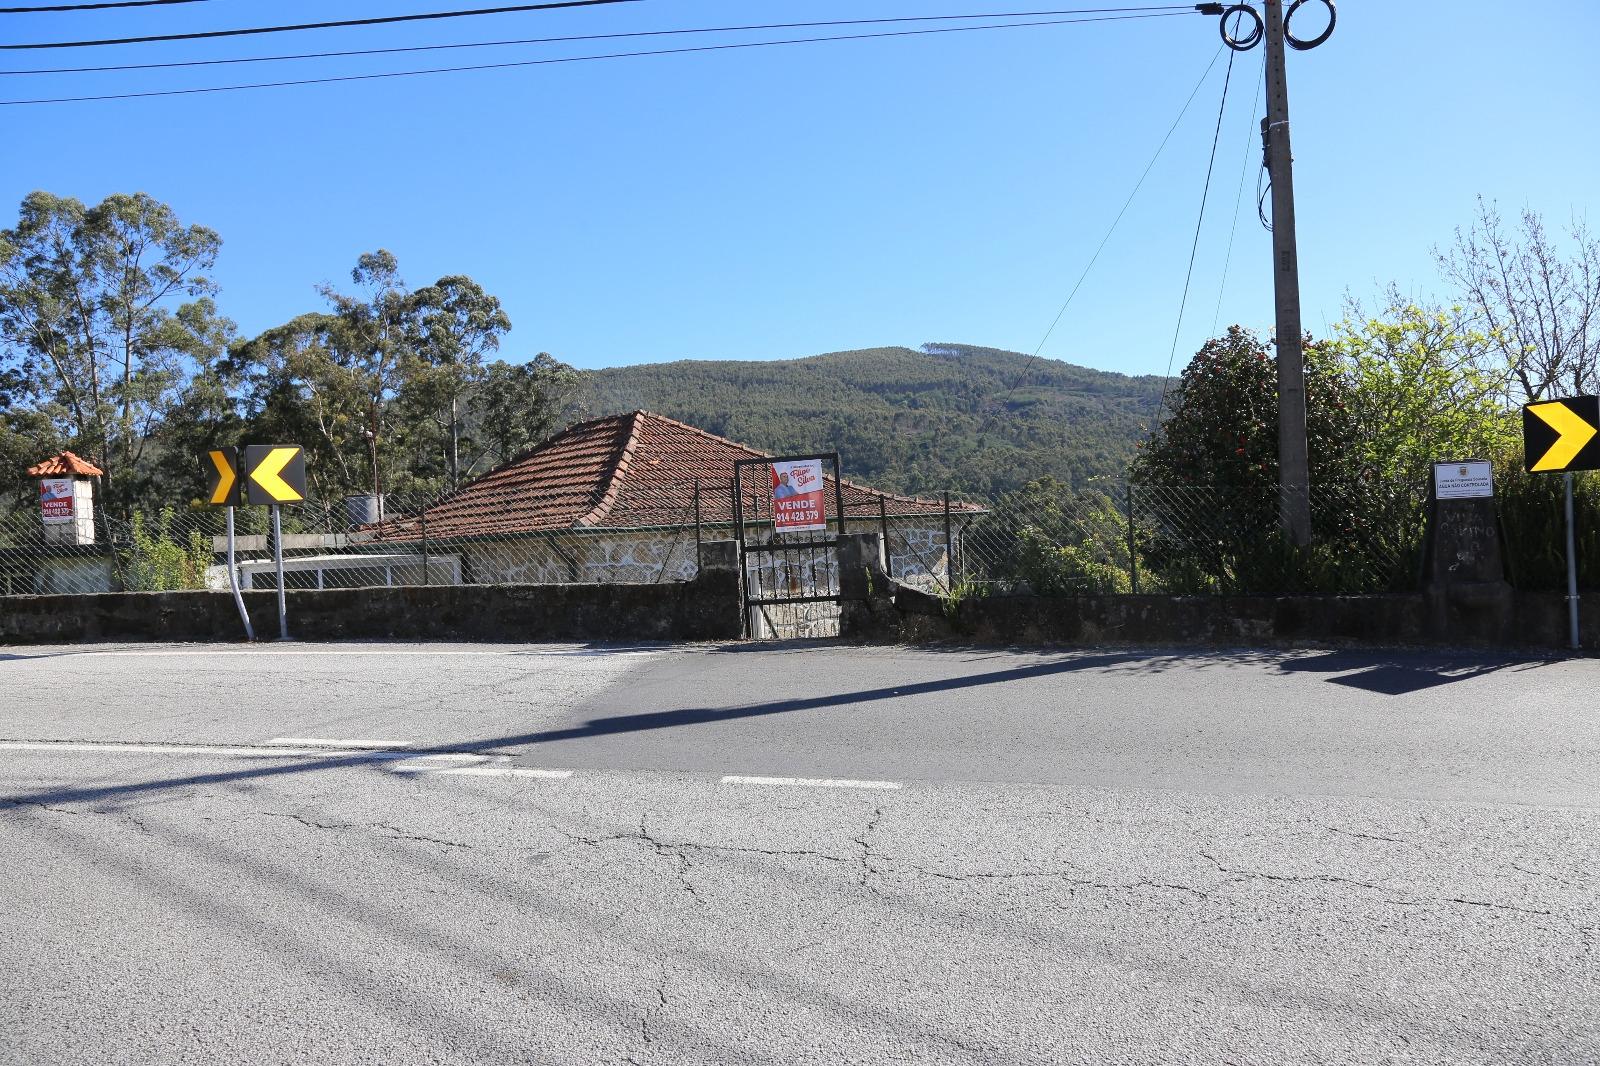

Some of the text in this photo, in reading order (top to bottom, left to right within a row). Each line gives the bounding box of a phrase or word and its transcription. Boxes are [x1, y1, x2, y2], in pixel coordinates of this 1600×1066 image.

[798, 475, 816, 486] Silva
[778, 500, 816, 510] VENDE
[776, 510, 818, 522] 914 428 379
